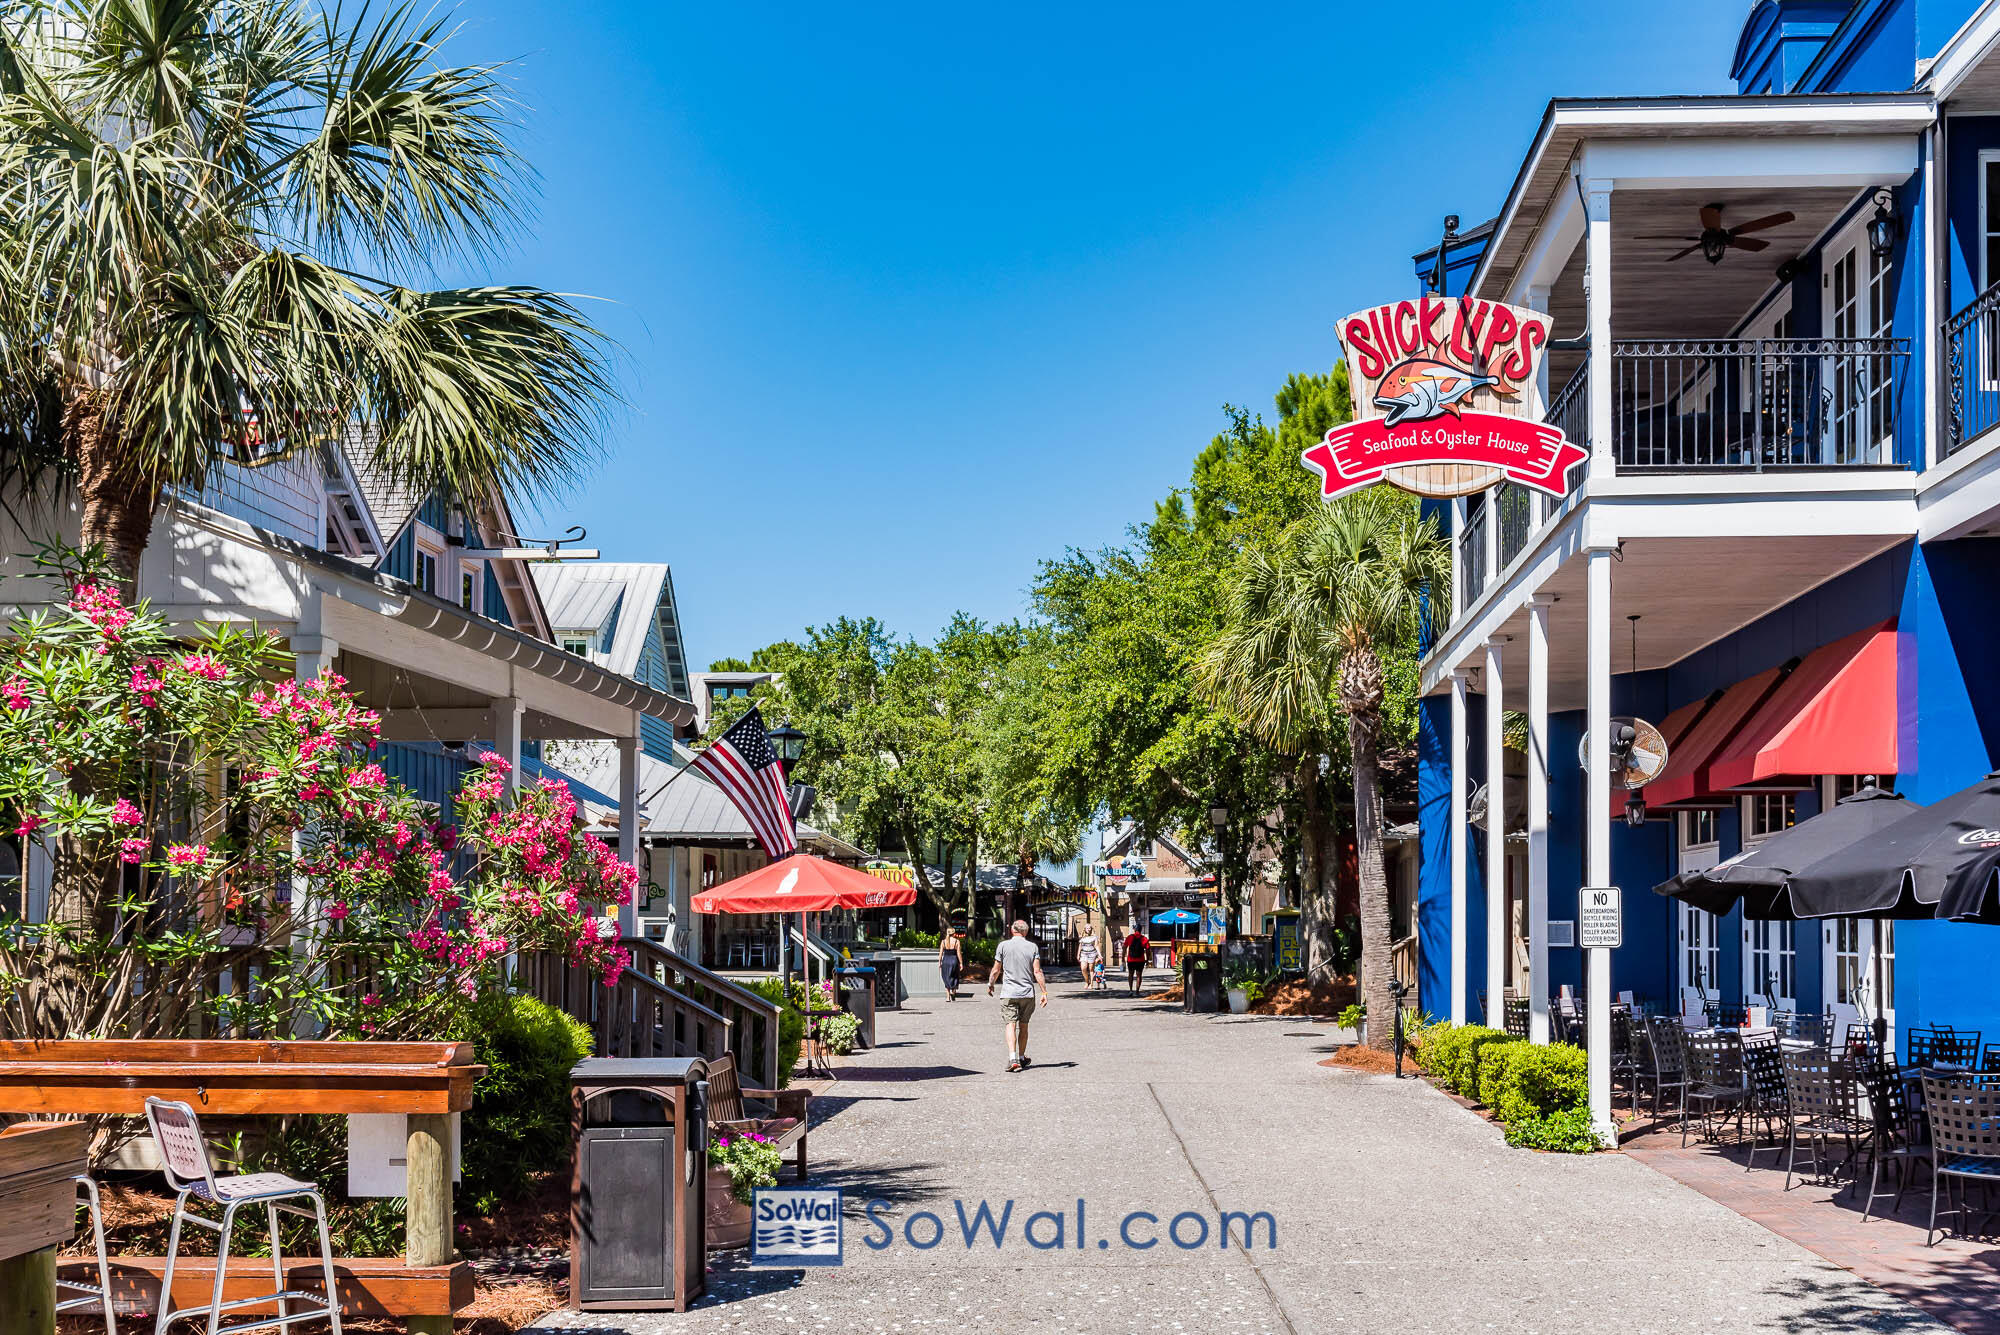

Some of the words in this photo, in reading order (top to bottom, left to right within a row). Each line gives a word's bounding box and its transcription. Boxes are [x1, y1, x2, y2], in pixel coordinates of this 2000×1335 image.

[1362, 430, 1418, 454] Seafood
[1421, 429, 1433, 445] &
[1435, 428, 1482, 450] Oyster
[1487, 432, 1529, 454] House
[1067, 889, 1099, 912] DOOR
[1593, 892, 1608, 906] NO
